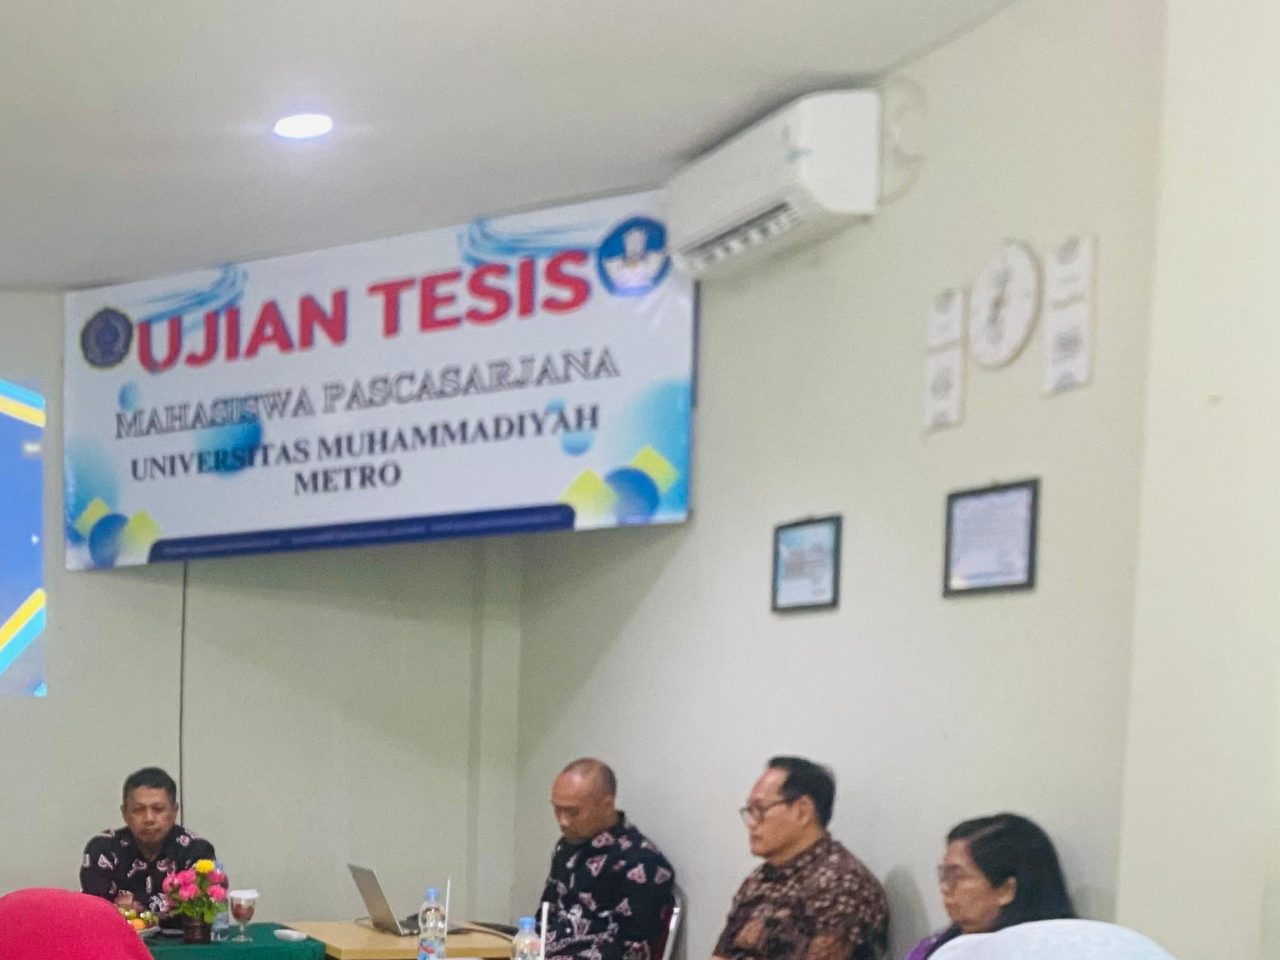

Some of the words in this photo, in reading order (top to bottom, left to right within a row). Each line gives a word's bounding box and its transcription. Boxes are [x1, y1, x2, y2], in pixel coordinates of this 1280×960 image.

[136, 288, 348, 374] UJIAN
[367, 249, 592, 338] TESIS
[115, 385, 316, 439] MAHASISWA
[322, 345, 621, 414] PASCASARJANA
[131, 438, 311, 481] UNIVERSITAS
[318, 404, 600, 460] MUHAMMADIYAH
[294, 462, 401, 495] METRO
